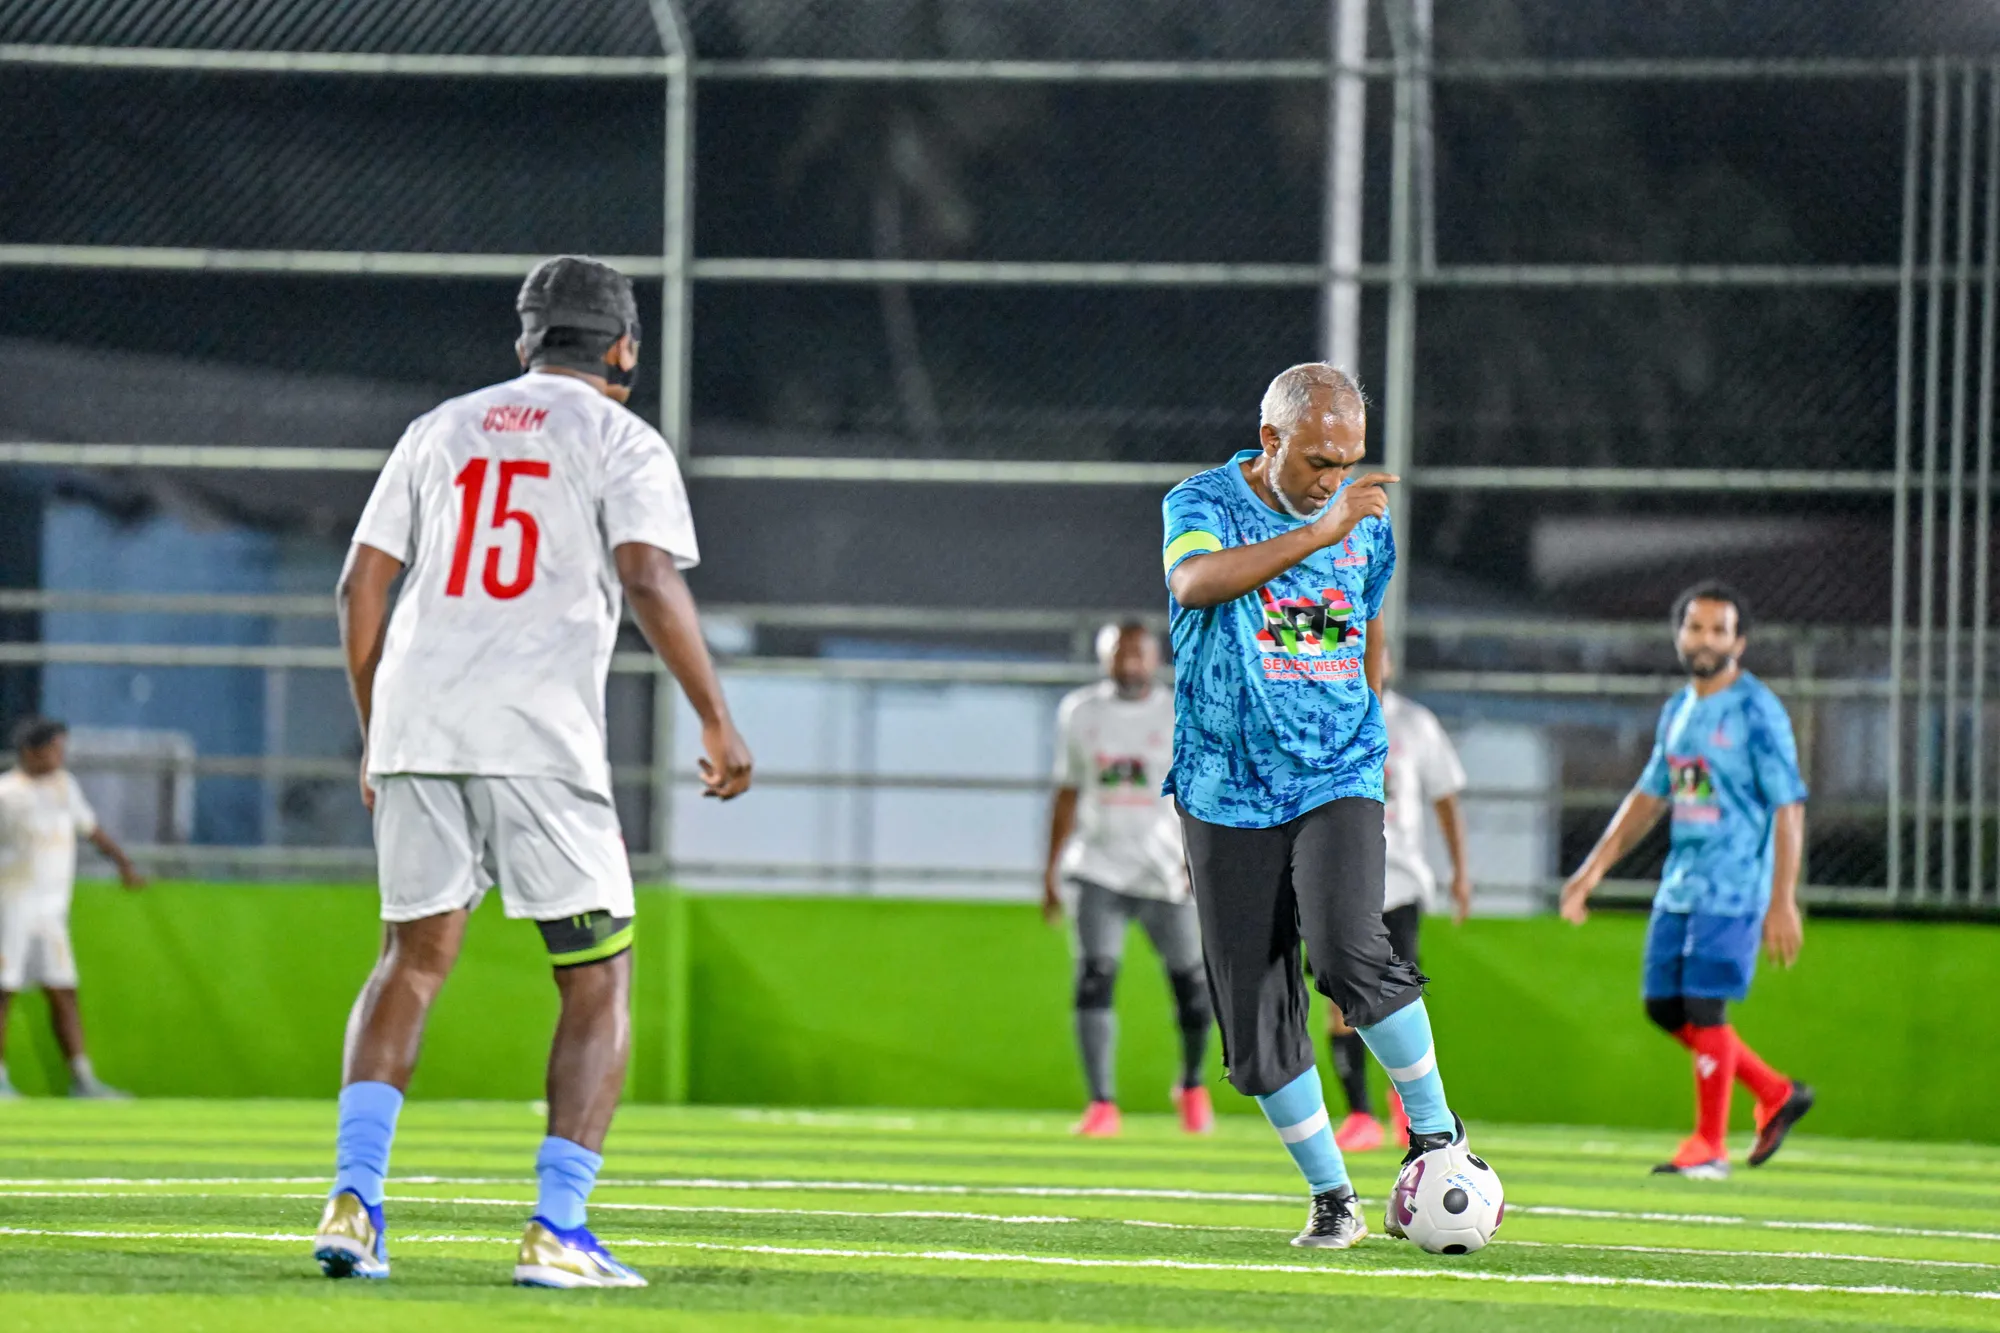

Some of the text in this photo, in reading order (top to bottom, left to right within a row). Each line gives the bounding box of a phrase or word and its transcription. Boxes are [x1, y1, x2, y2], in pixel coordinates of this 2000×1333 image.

[444, 457, 550, 600] 15
[1263, 657, 1359, 672] SEVEN WEEKS
